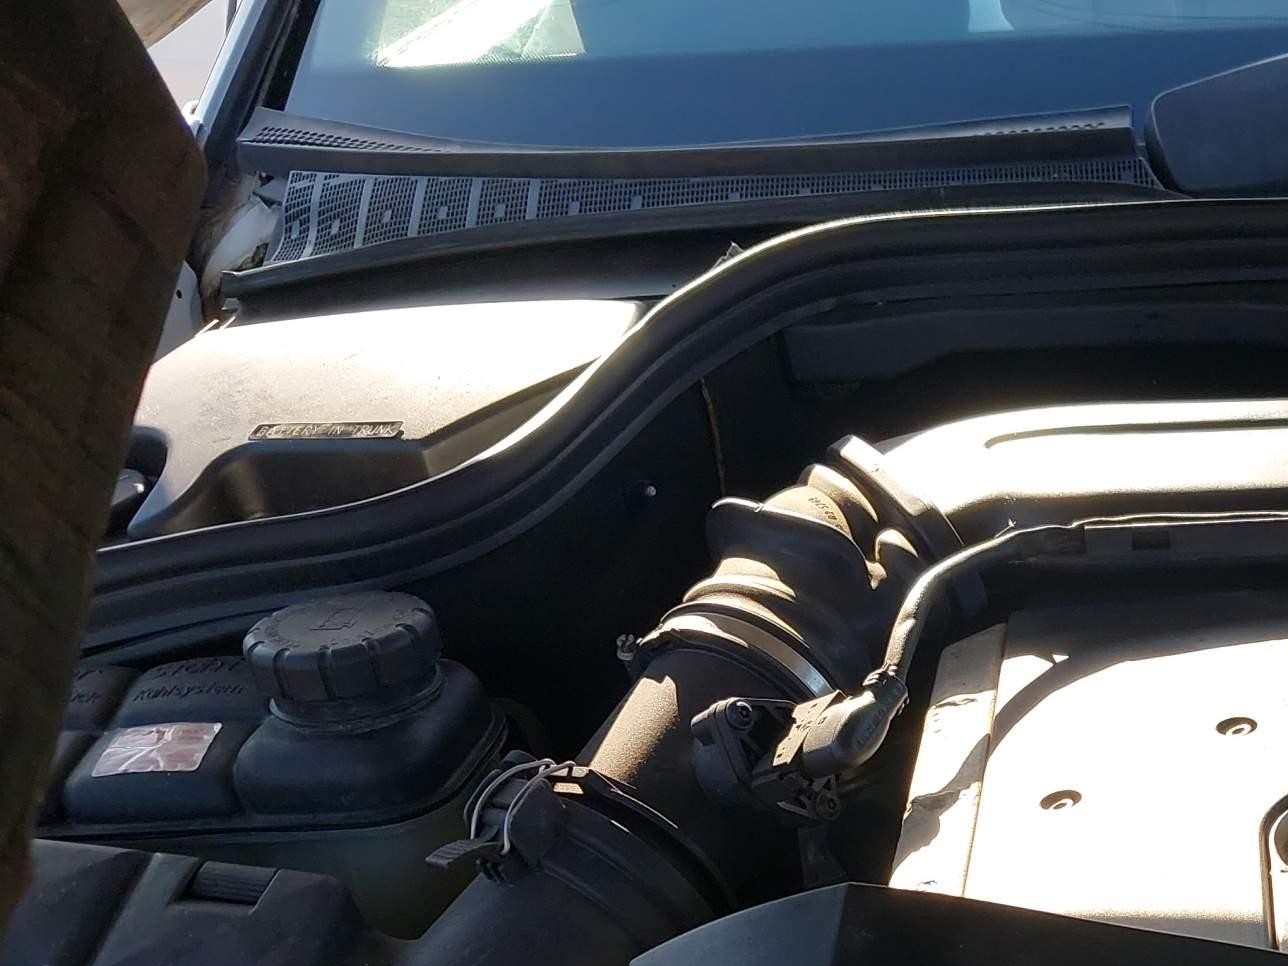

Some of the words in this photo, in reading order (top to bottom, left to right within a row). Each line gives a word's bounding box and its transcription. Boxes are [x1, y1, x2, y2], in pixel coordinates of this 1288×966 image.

[256, 424, 320, 438] BATTERY
[328, 424, 343, 436] IN
[353, 423, 396, 436] TRUNK
